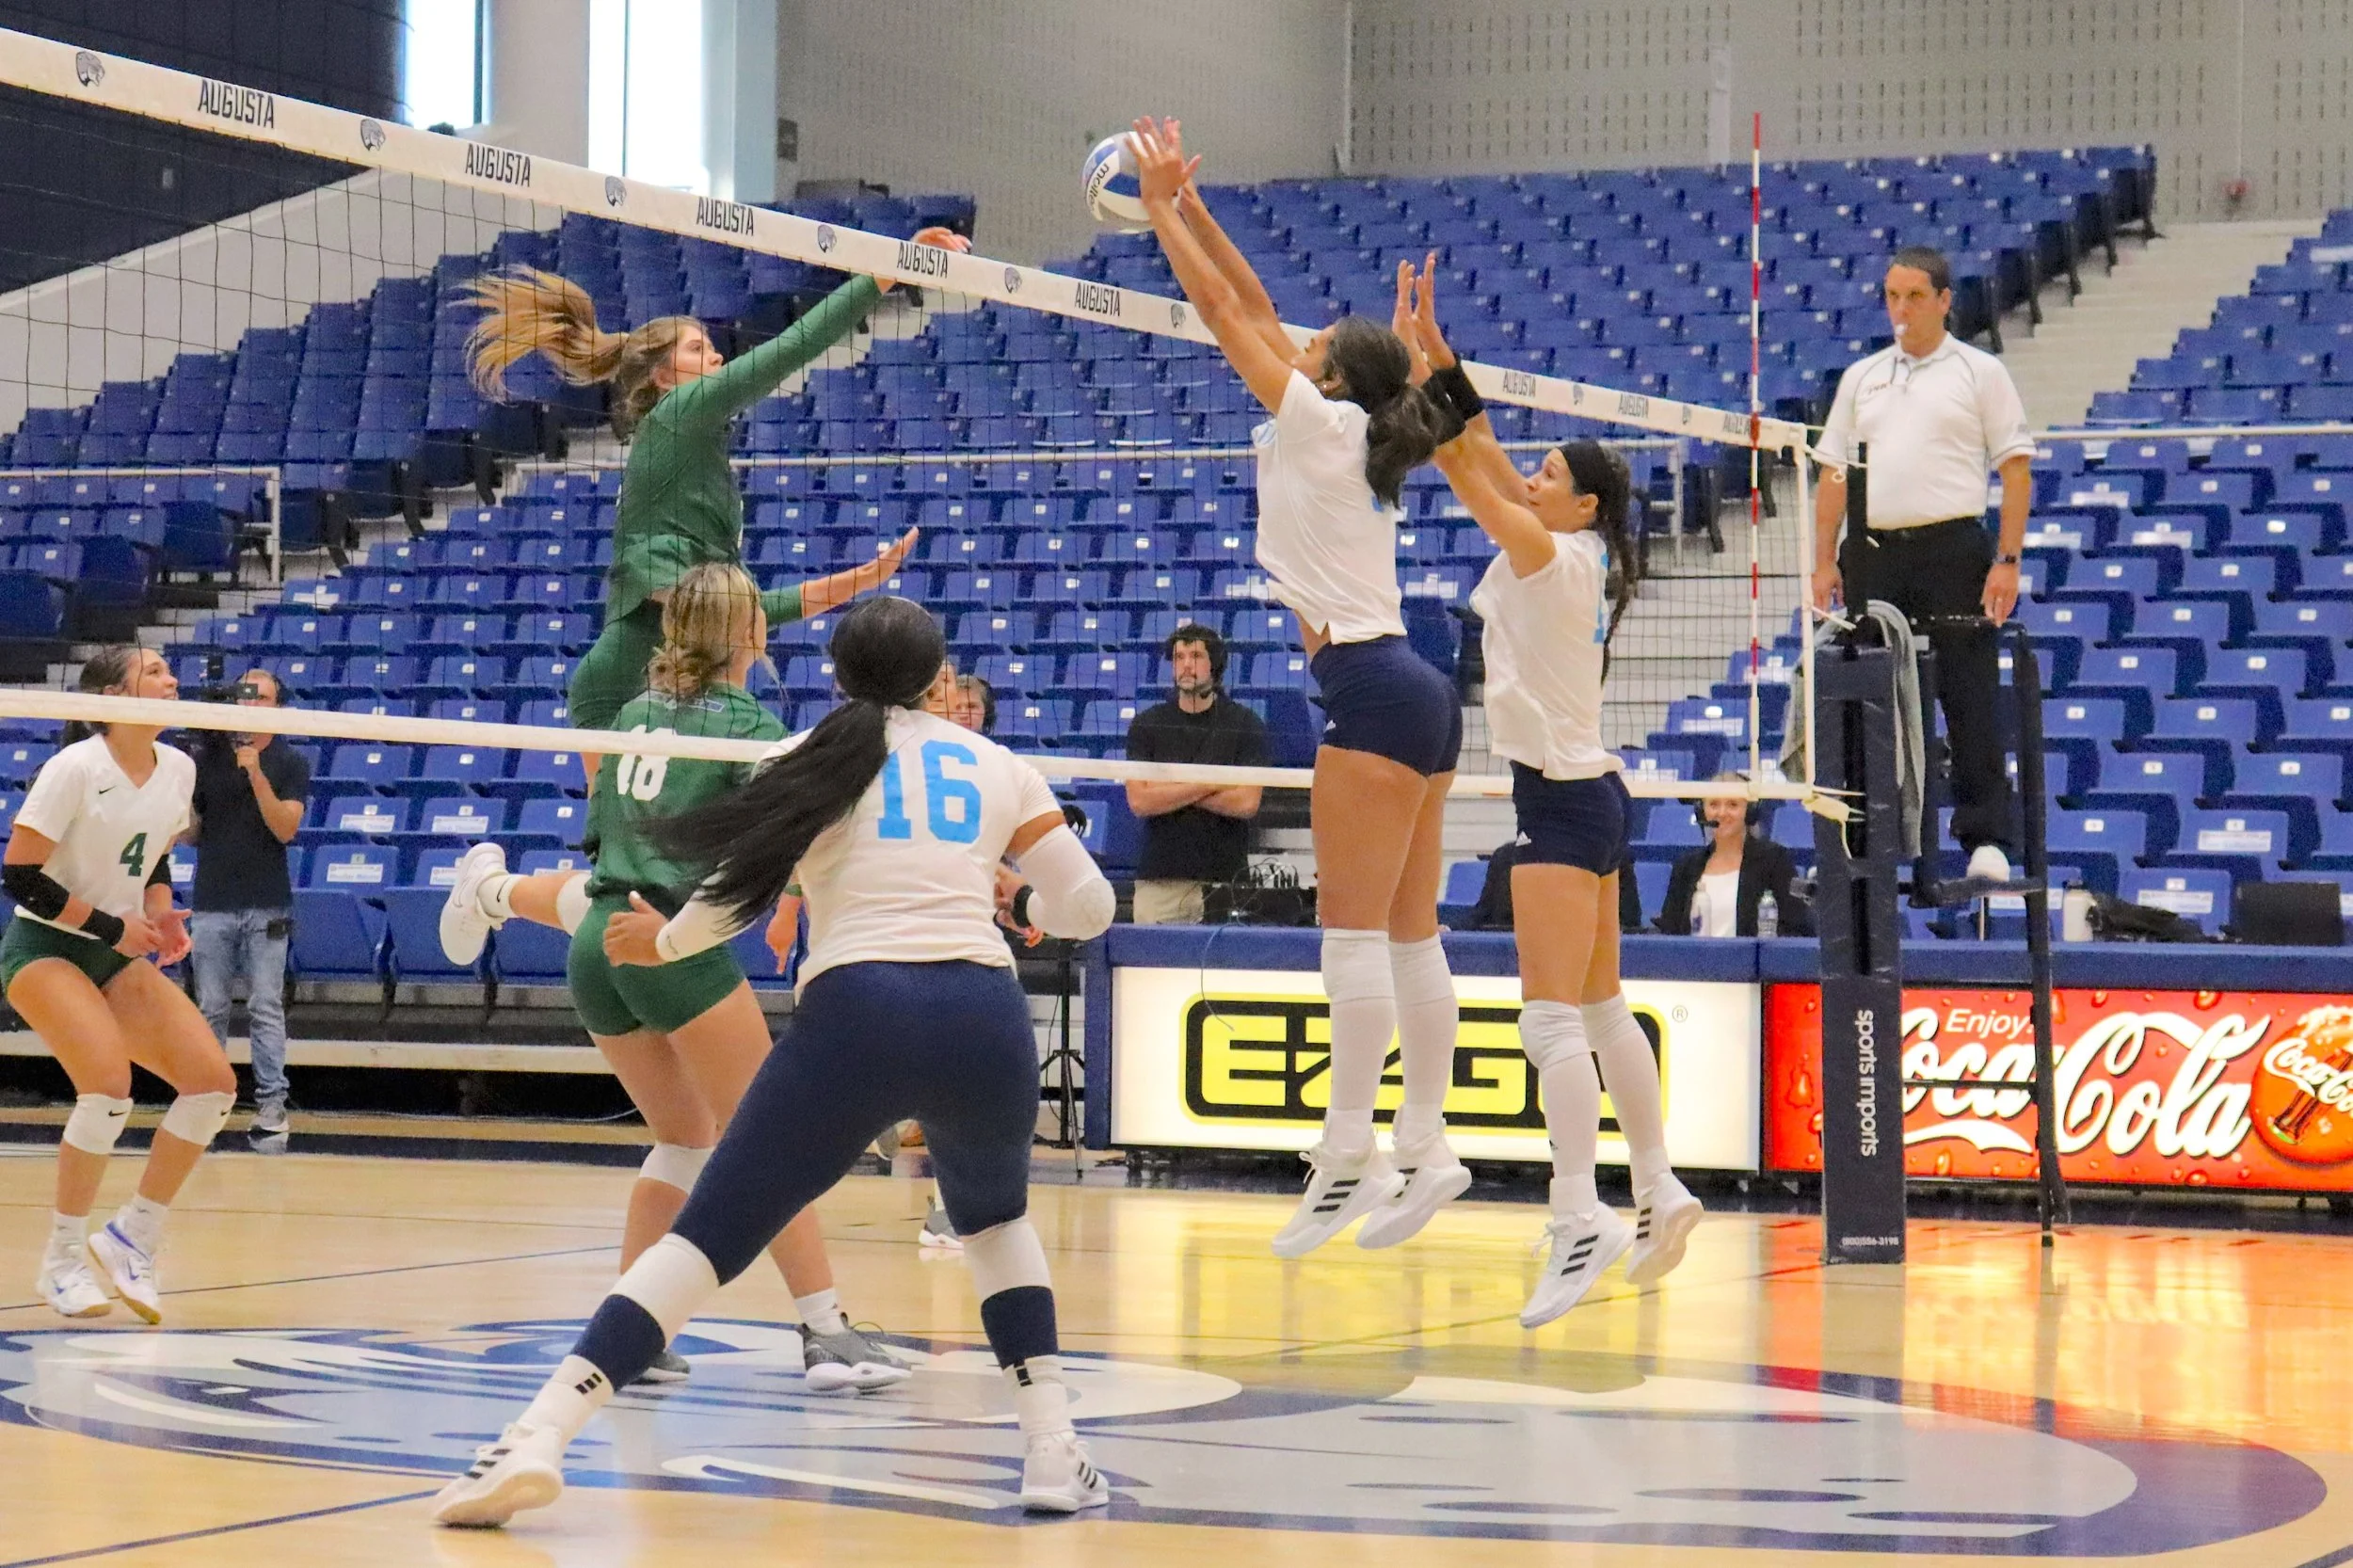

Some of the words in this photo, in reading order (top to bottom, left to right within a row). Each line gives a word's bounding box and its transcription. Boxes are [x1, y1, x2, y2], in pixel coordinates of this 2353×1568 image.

[198, 78, 275, 129] AUGUSTA
[465, 142, 531, 187] AUGUSTA
[696, 196, 754, 236] AUGUSTA
[896, 241, 948, 279] AUGUSTA
[1074, 281, 1121, 317] AUGUSTA
[877, 739, 982, 844] 16
[119, 832, 148, 876] 4
[1854, 1009, 1878, 1075] sports
[1201, 1015, 1647, 1122] EZG
